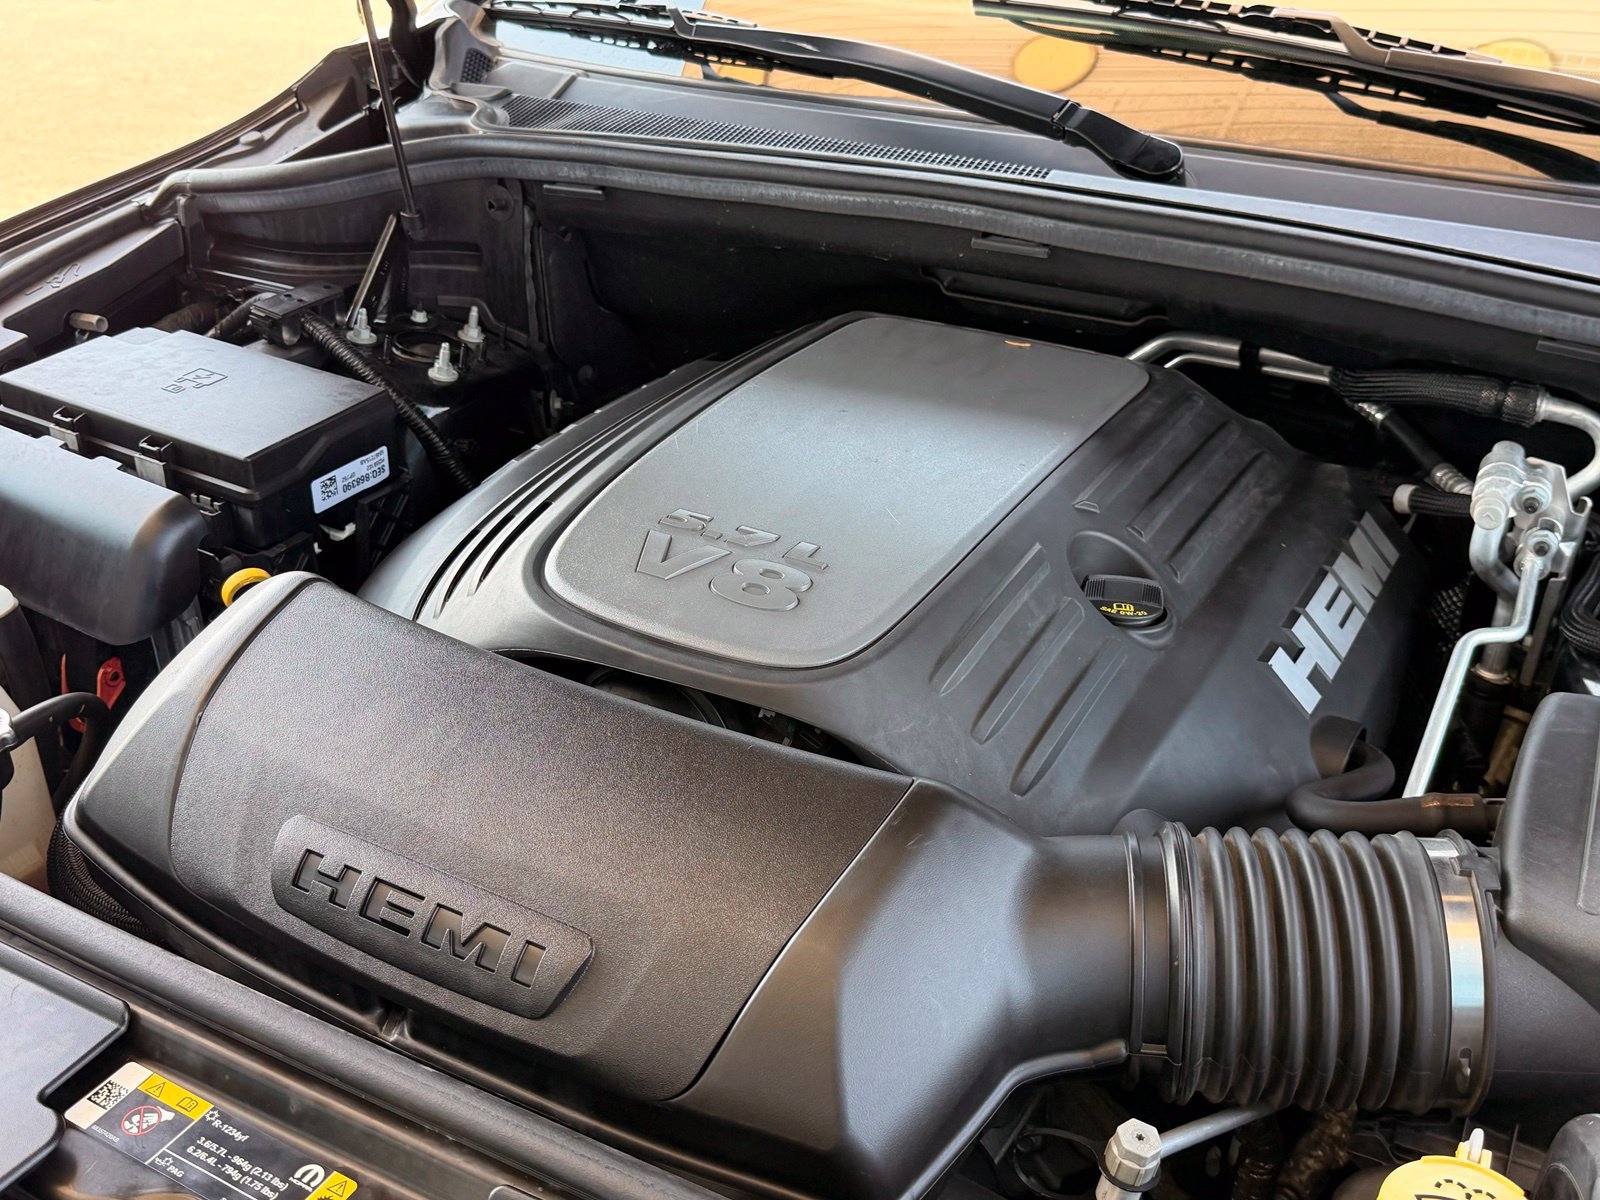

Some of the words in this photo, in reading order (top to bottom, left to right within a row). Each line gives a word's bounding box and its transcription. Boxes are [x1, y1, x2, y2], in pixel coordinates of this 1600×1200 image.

[342, 464, 386, 493] SEQ:868390
[657, 507, 830, 570] 5.7L
[634, 529, 814, 612] V8
[1099, 606, 1118, 615] SAE
[1267, 511, 1400, 715] HEMI
[291, 848, 547, 989] HEMI
[211, 1119, 250, 1142] R-1234yf
[166, 1164, 185, 1178] PAG
[186, 1145, 218, 1167] 6.2/6.4L
[221, 1164, 243, 1182] 794g
[239, 1175, 264, 1191] (1.75
[260, 1186, 279, 1200] lbs)
[196, 1136, 228, 1158] 3.6/5.7L
[231, 1155, 252, 1172] 964g
[250, 1166, 273, 1182] (2.13
[270, 1177, 289, 1192] lbs)
